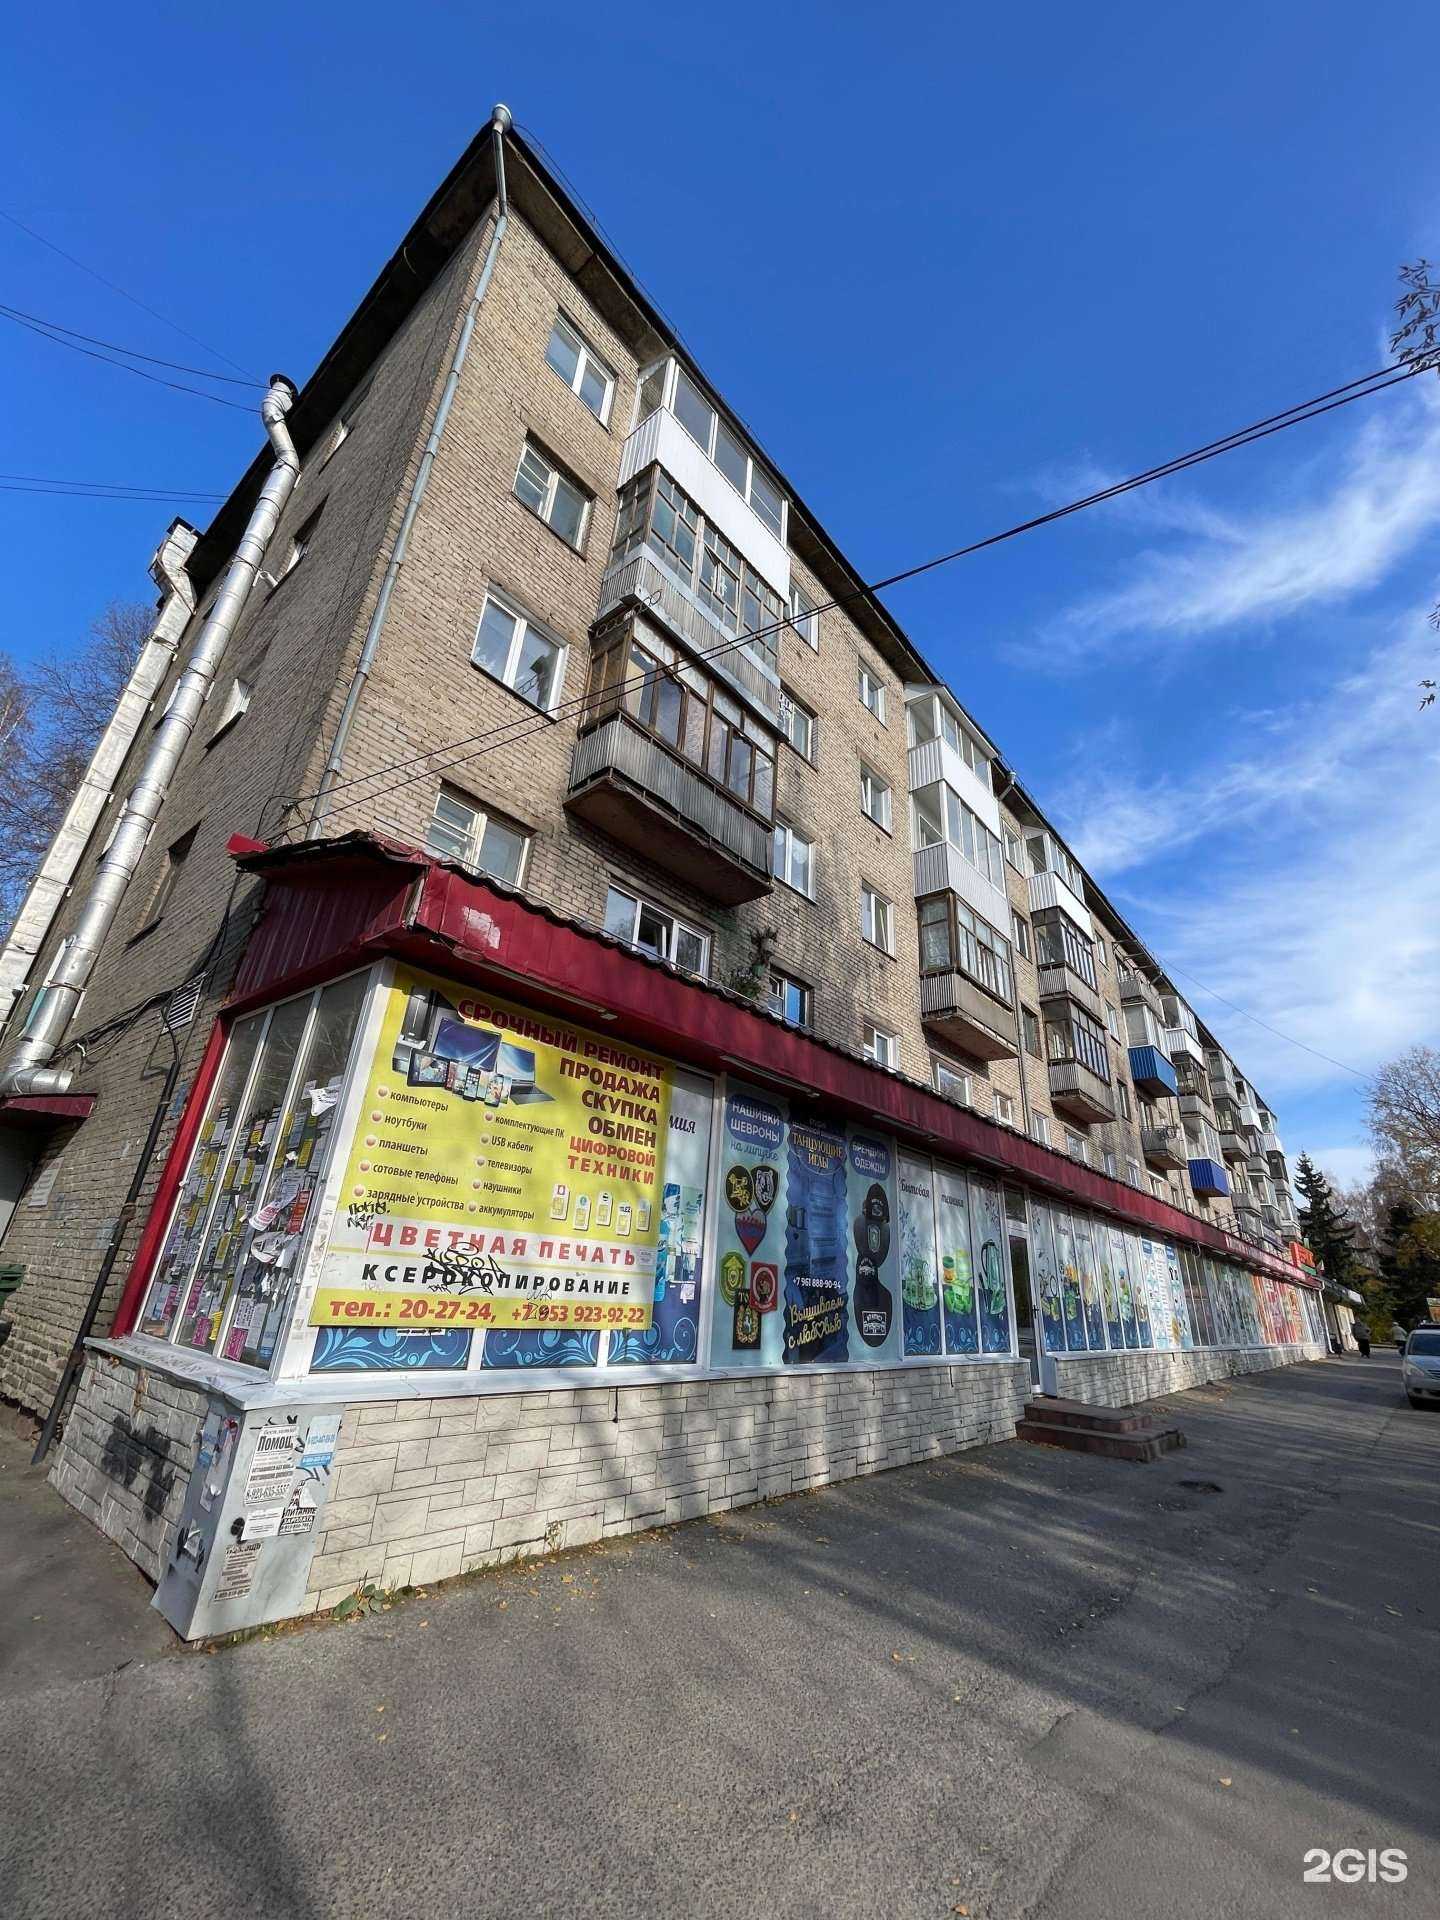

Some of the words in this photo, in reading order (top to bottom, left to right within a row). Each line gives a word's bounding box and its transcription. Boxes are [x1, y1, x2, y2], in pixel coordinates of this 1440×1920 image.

[457, 999, 578, 1053] СРОЧНЫЙ
[583, 1040, 665, 1081] РЕМОНТ
[559, 1057, 661, 1104] ПРОДАЖА
[390, 1091, 449, 1112] компьютеры
[581, 1089, 658, 1126] СКУПКА
[384, 1114, 428, 1132] ноутбуки
[732, 1103, 780, 1126] НАШИВКИ
[495, 1116, 555, 1136] комплектующие
[555, 1127, 565, 1138] ПК
[588, 1116, 657, 1148] ОБМЕН
[730, 1118, 780, 1143] ШЕВРОНЫ
[378, 1139, 429, 1156] планшеты
[491, 1135, 506, 1147] USB
[506, 1140, 534, 1153] кабели
[569, 1136, 656, 1168] ЦИФРОВОЙ
[487, 1159, 533, 1175] телевизоры
[568, 1155, 655, 1185] ТЕХНИКИ
[808, 1153, 830, 1170] ИГЛЫ
[372, 1164, 413, 1178] сотовые
[414, 1170, 459, 1186] телефоны
[483, 1182, 522, 1195] наушники
[366, 1189, 416, 1204] зарядные
[416, 1195, 465, 1211] устройства
[478, 1205, 535, 1220] аккумуляторы
[372, 1222, 528, 1257] ЦВЕТНАЯ
[538, 1241, 636, 1266] ПЕЧАТЬ
[361, 1263, 631, 1295] КСЕРОКОПИРОВАНИЕ
[329, 1300, 392, 1318] тел.:
[398, 1299, 497, 1323] 20-27-24,
[574, 1305, 645, 1323] 923-92-22
